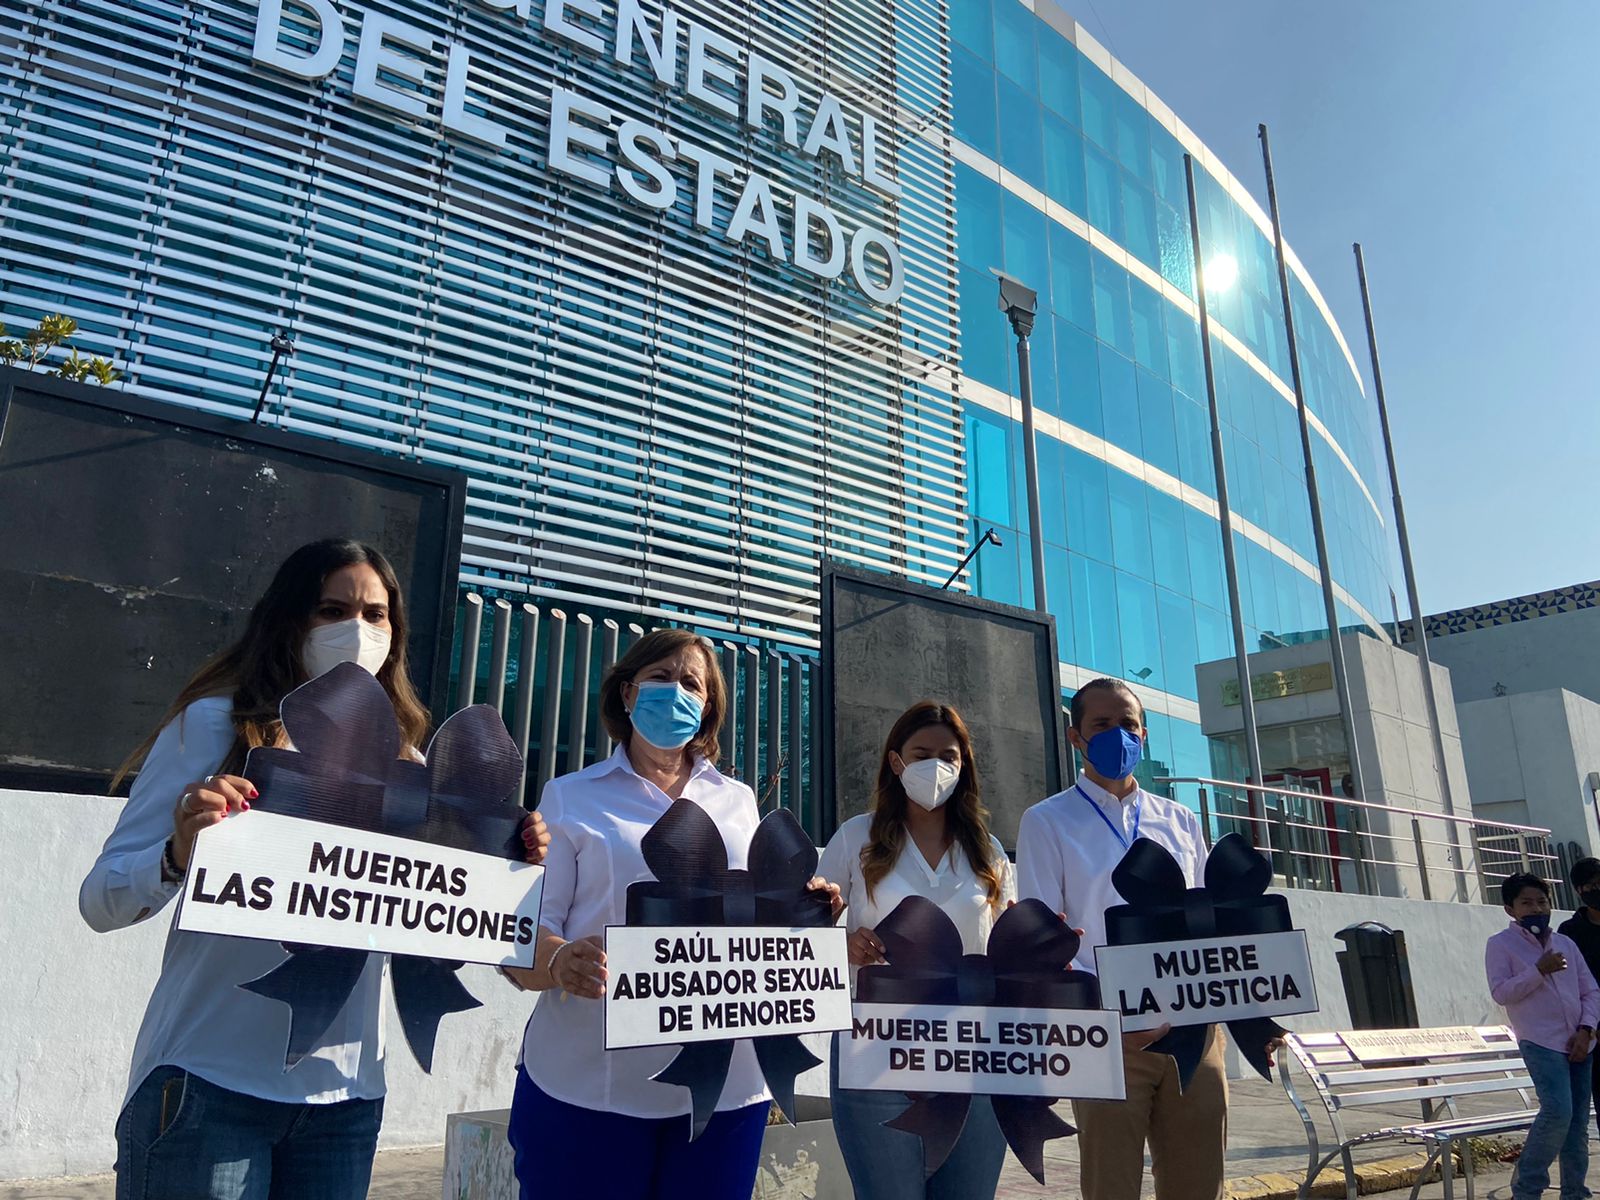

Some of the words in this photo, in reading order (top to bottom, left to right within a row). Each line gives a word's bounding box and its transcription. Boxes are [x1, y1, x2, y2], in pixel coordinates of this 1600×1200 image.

[482, 0, 902, 198] ENERAL
[252, 0, 507, 149] DEL
[549, 86, 905, 305] ESTADO
[308, 841, 468, 897] MUERTAS
[191, 867, 275, 911] LAS
[287, 881, 534, 945] INSTITUCIONES
[655, 931, 721, 964] SAÚL
[728, 937, 815, 962] HUERTA
[1153, 944, 1259, 979] MUERE
[612, 969, 757, 1001] ABUSADOR
[764, 967, 845, 993] SEXUAL
[1118, 987, 1161, 1017] LA
[1170, 974, 1301, 1011] JUSTICIA
[659, 1005, 693, 1033] DE
[702, 998, 816, 1030] MENORES
[852, 1017, 948, 1043] MUERE
[957, 1020, 991, 1044] EL
[998, 1022, 1109, 1048] ESTADO
[890, 1047, 925, 1071] DE
[935, 1049, 1071, 1077] DERECHO
